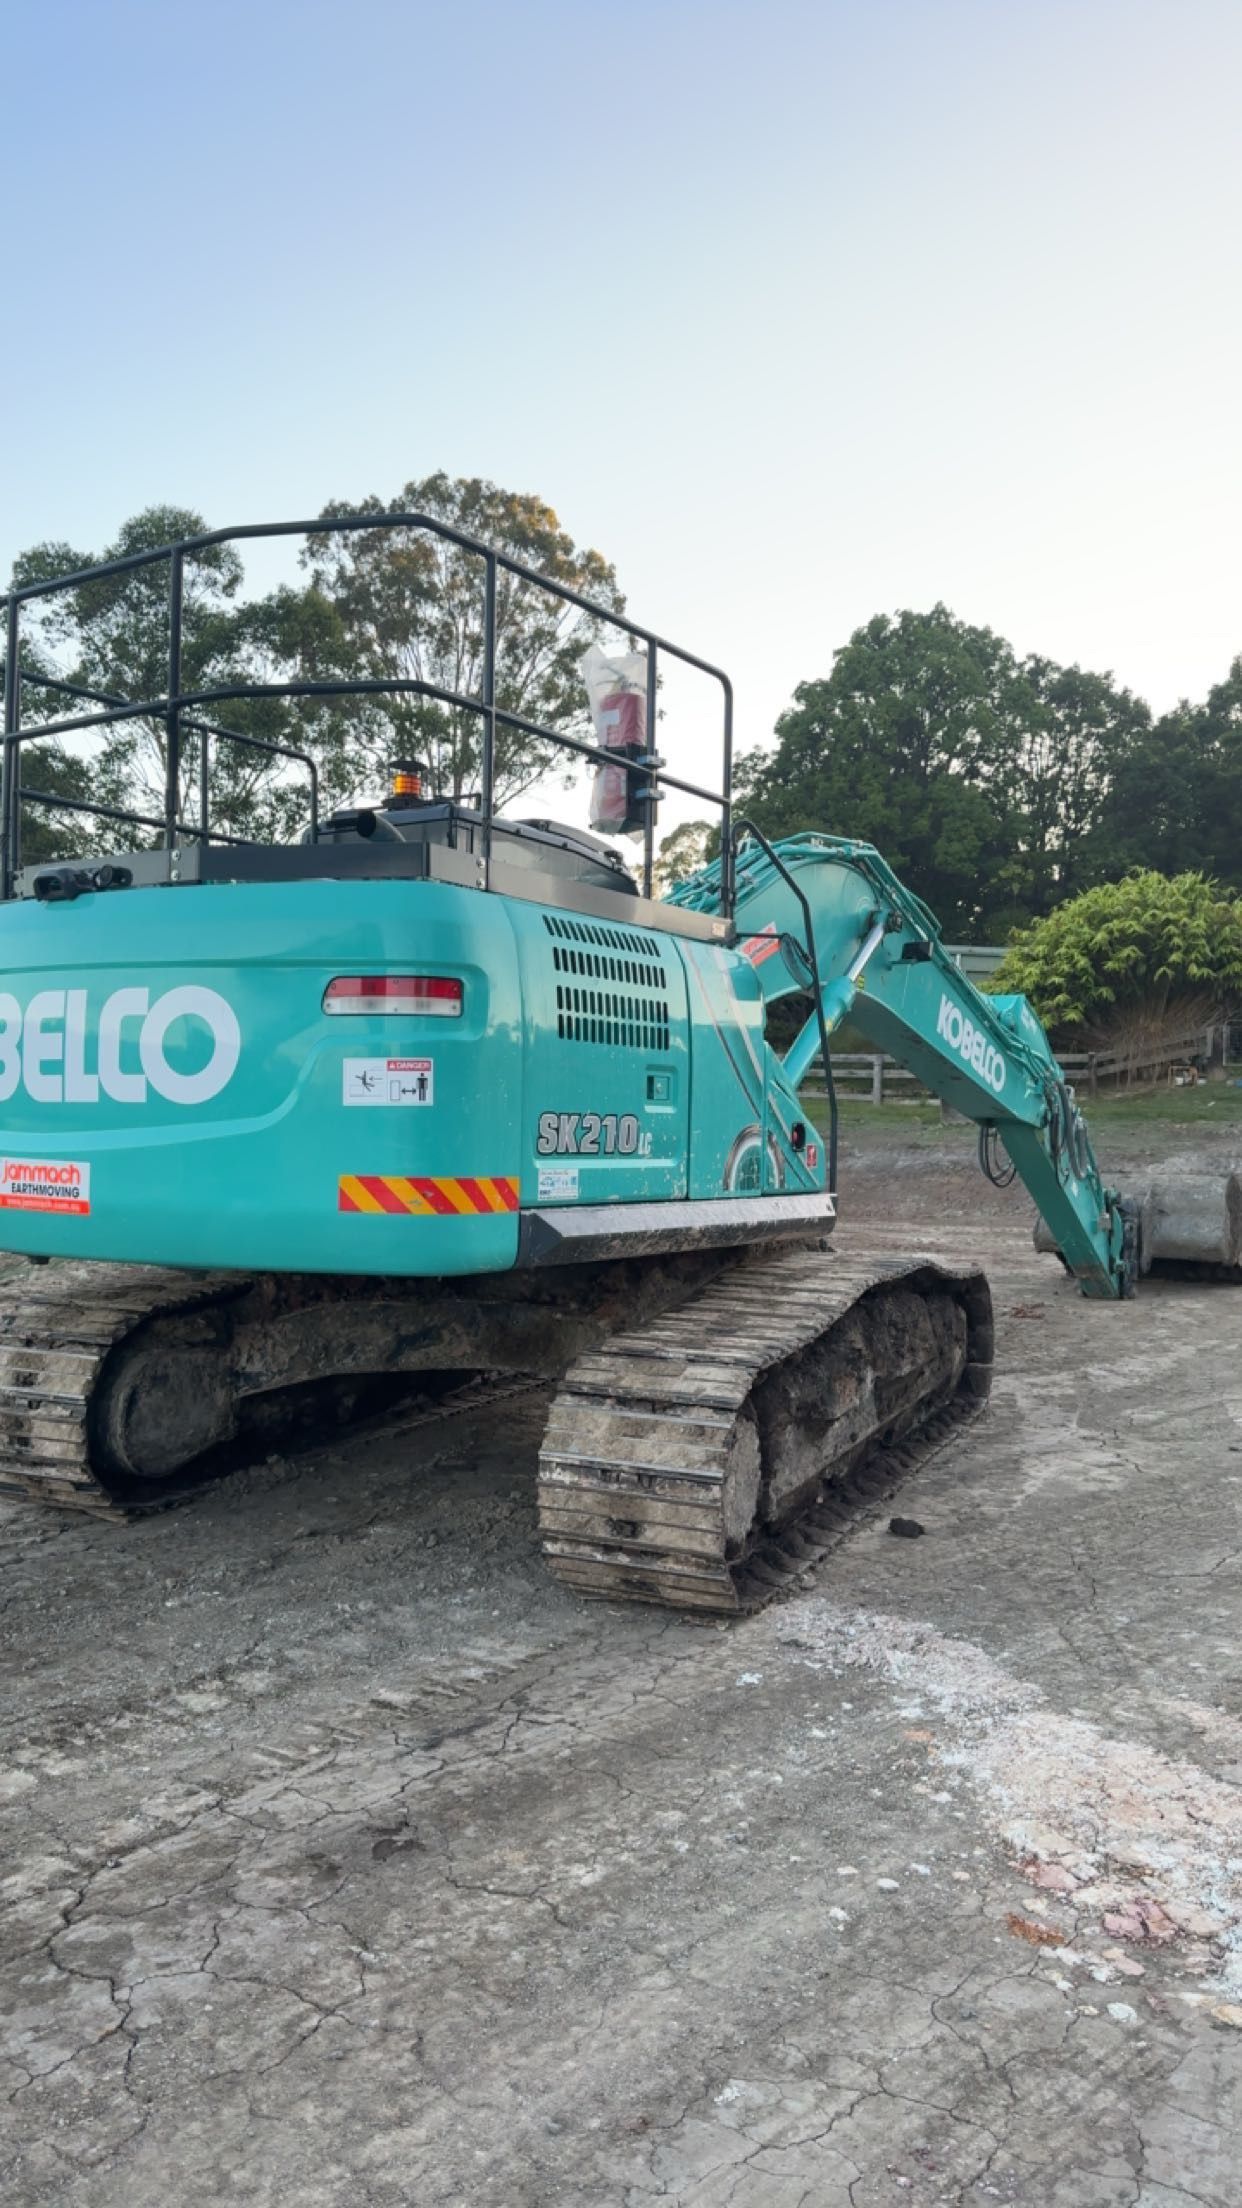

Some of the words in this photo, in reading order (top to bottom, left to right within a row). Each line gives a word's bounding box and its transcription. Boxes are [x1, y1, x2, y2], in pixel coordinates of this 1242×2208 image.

[937, 993, 1006, 1092] KOBELCO
[396, 1061, 431, 1070] DANGER
[537, 1111, 639, 1155] SK210
[2, 1160, 80, 1185] jammach
[11, 1182, 80, 1198] EARTHMOVING
